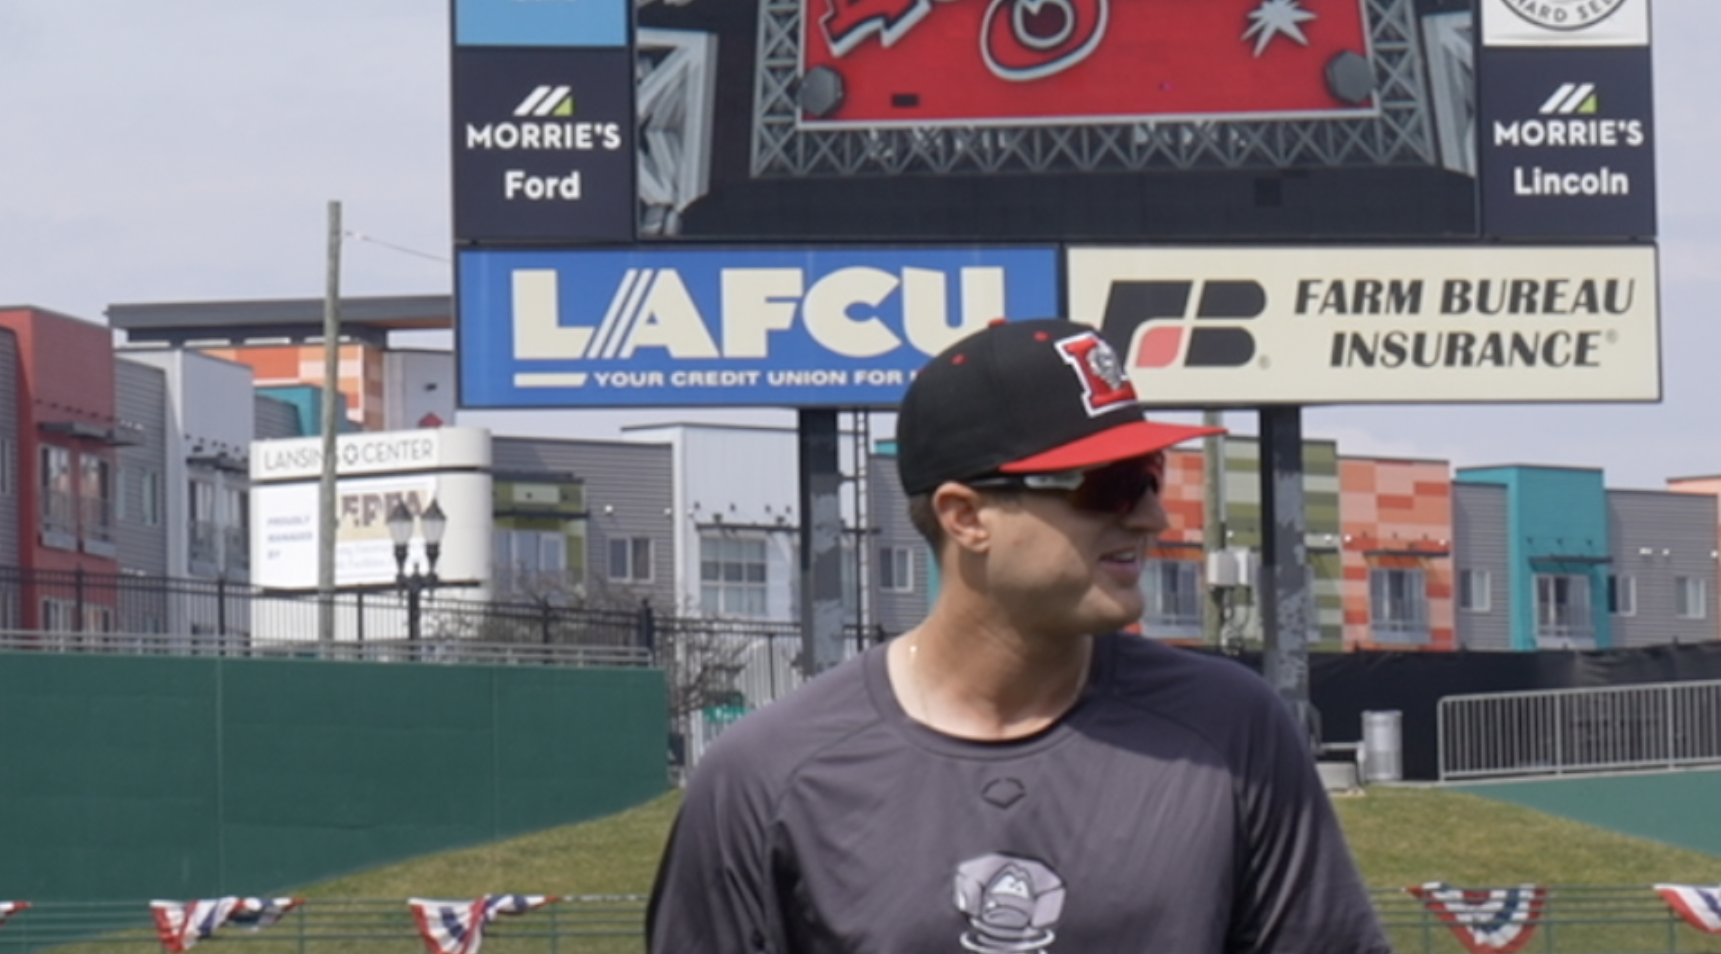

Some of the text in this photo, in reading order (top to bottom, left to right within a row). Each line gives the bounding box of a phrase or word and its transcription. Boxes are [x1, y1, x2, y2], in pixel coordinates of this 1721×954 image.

[467, 122, 621, 150] MORRIE'S
[1493, 119, 1644, 146] MORRIE'S
[505, 170, 580, 200] Ford
[1514, 167, 1629, 195] Lincoln
[1294, 278, 1635, 316] FARM BUREAU
[511, 265, 1006, 361] LAFCU
[1329, 331, 1601, 368] INSURANCE
[593, 371, 665, 388] YOUR
[670, 370, 761, 388] CREDIT
[767, 370, 848, 387] UNION
[853, 369, 903, 387] FOR
[363, 438, 434, 463] CENTER
